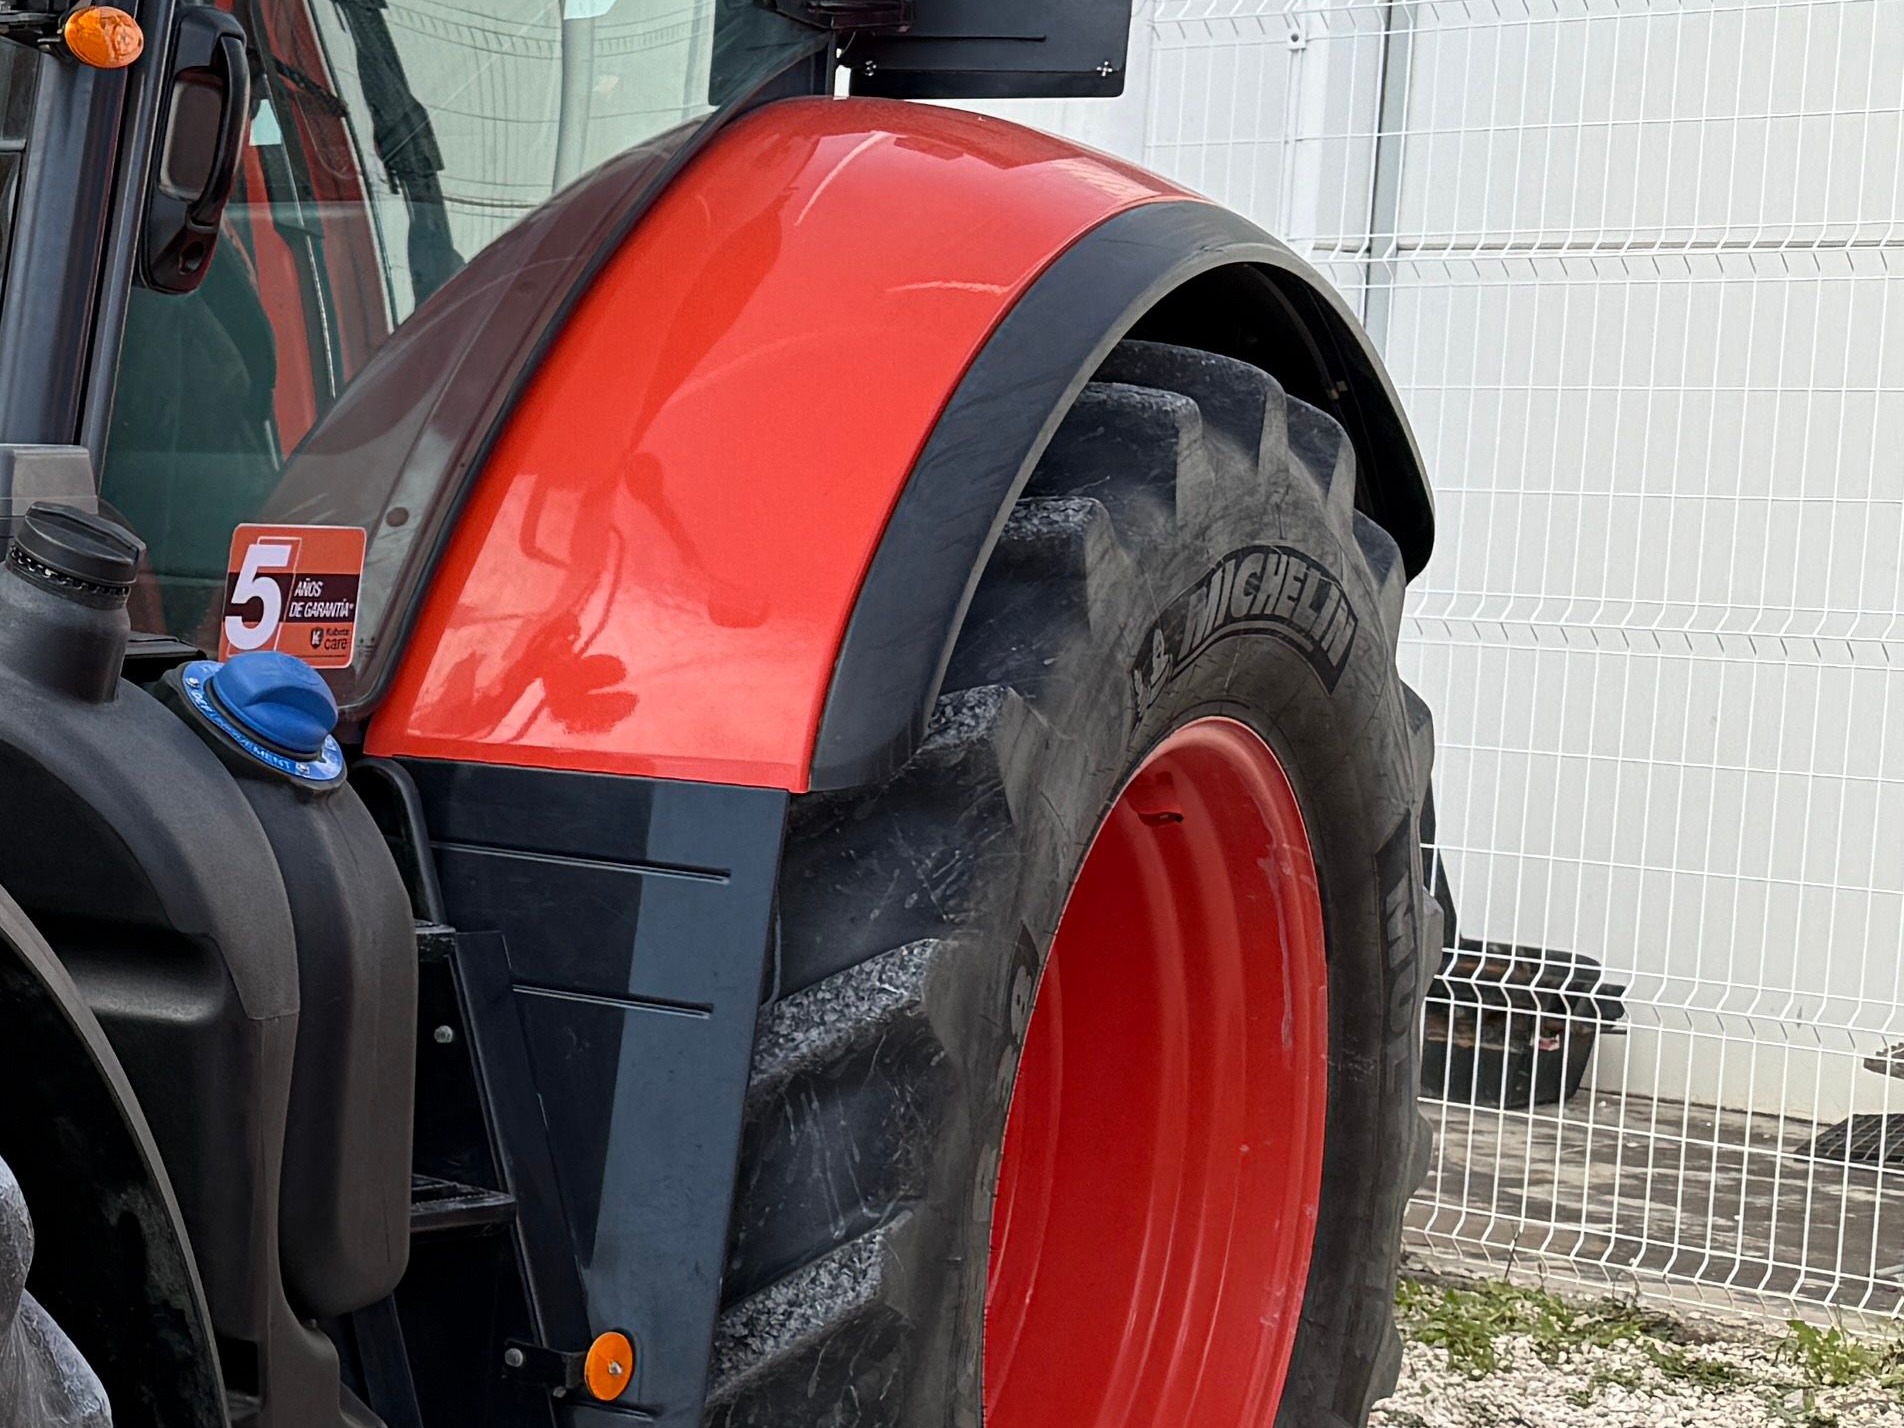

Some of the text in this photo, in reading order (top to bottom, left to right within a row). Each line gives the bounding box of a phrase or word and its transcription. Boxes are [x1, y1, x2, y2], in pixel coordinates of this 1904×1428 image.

[224, 544, 292, 650] 5
[294, 578, 323, 597] AÑOS
[289, 601, 305, 618] DE
[1178, 551, 1353, 668] MICHELIN
[324, 637, 348, 651] care
